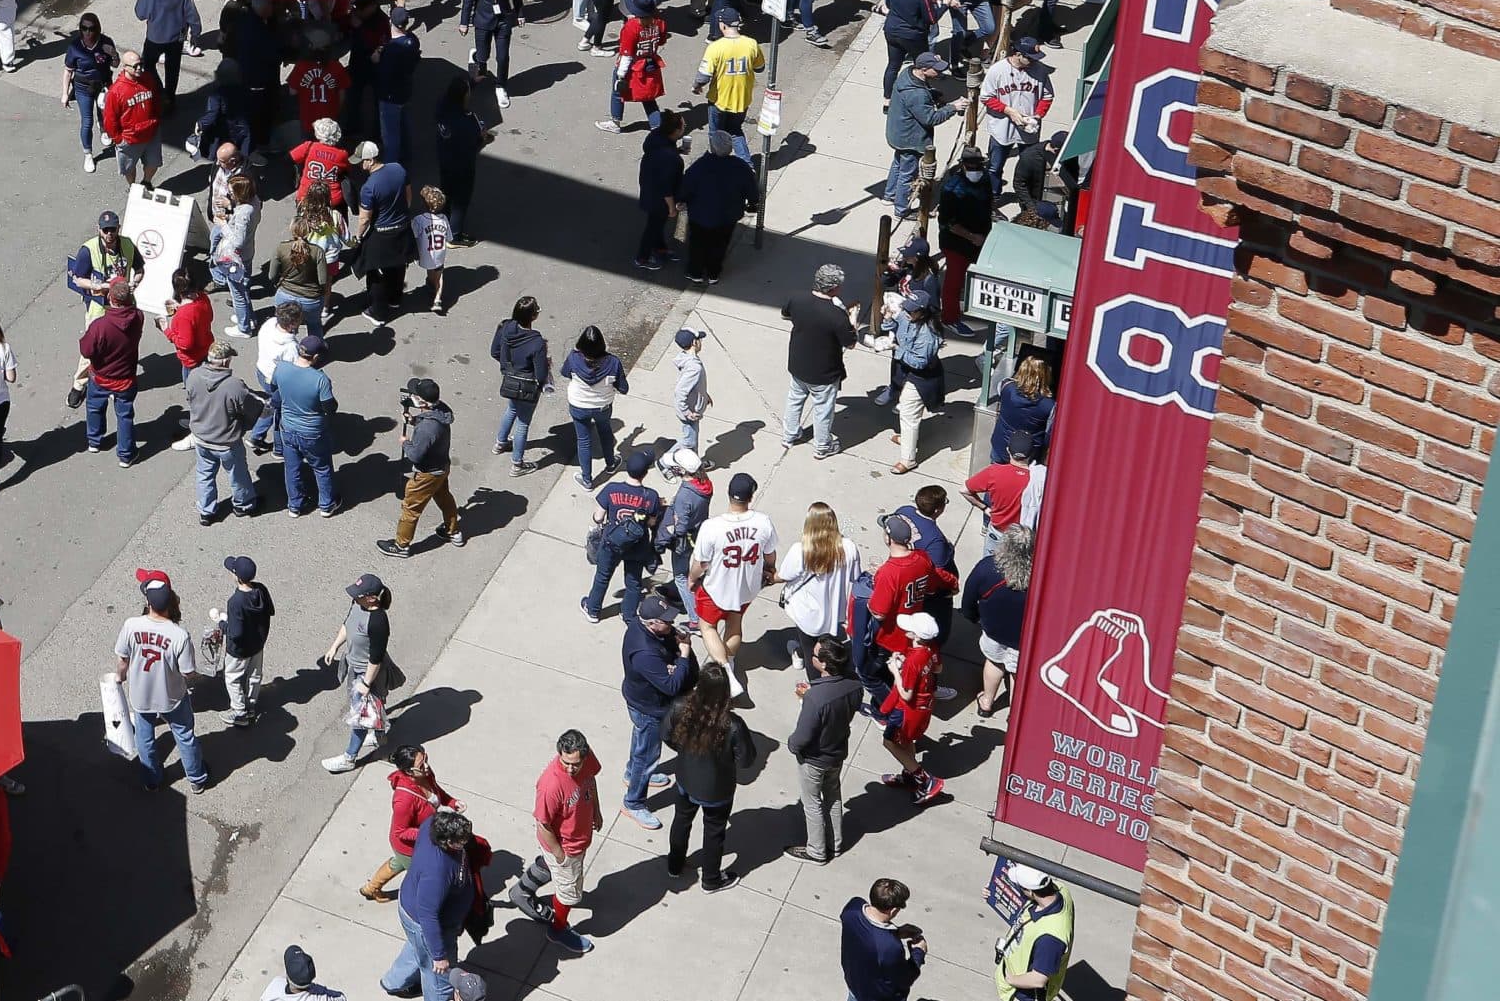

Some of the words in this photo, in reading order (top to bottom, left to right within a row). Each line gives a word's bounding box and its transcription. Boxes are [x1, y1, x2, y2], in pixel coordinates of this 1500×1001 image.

[724, 56, 748, 75] 11
[299, 68, 324, 88] SCOTTY
[310, 84, 328, 102] 11
[998, 80, 1040, 97] BOSTON
[307, 161, 338, 181] 34
[427, 234, 445, 251] 19
[980, 279, 1001, 297] ICE
[1003, 283, 1037, 302] COLD
[978, 292, 1036, 317] BEER
[725, 526, 758, 543] ORTIZ
[722, 543, 760, 568] 34
[904, 575, 929, 608] 15
[133, 631, 172, 650] OWENS
[141, 648, 162, 673] 7
[1047, 759, 1156, 816] SERIES
